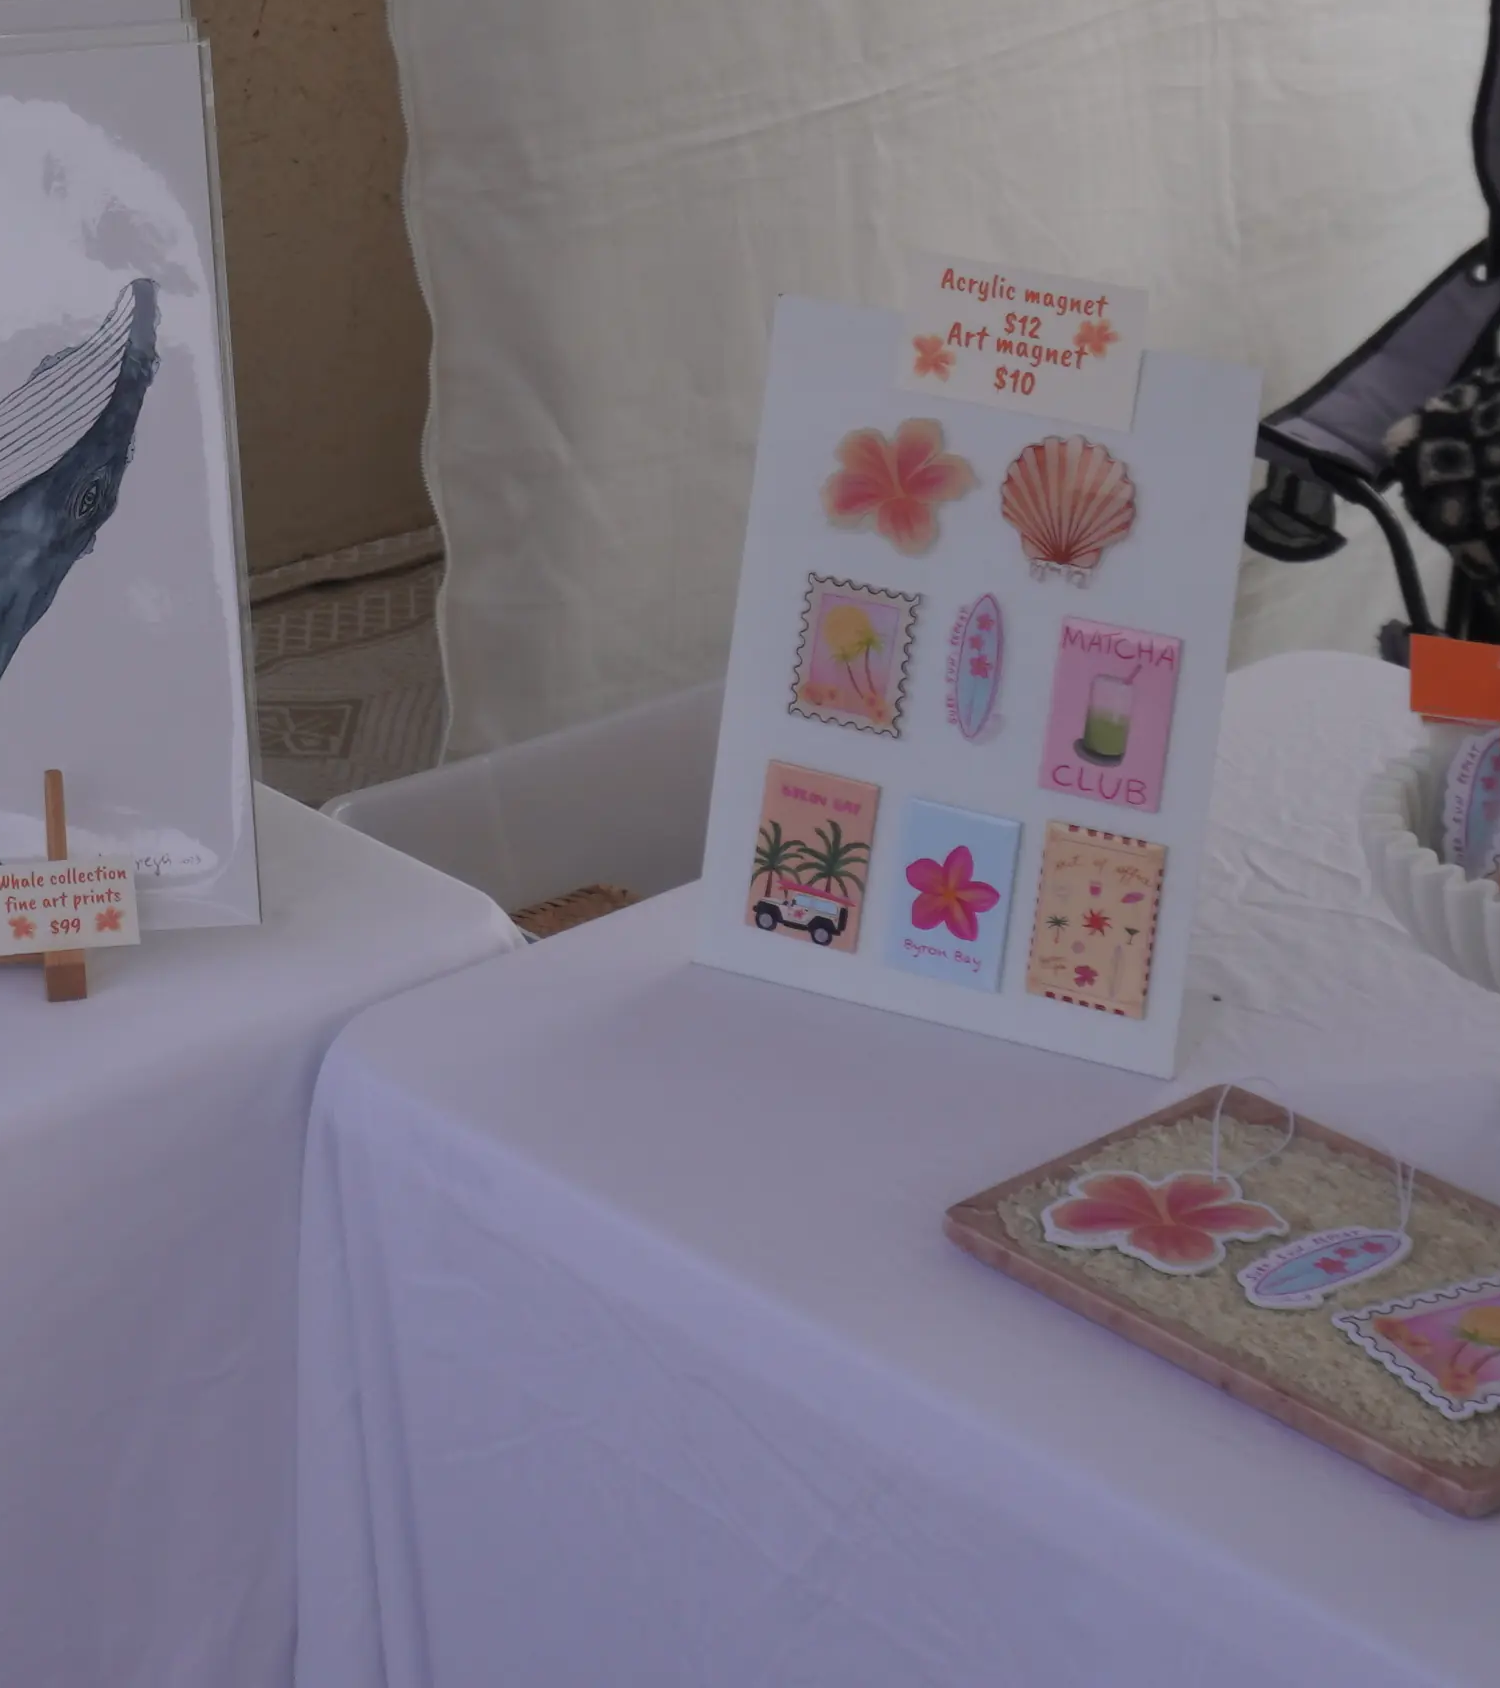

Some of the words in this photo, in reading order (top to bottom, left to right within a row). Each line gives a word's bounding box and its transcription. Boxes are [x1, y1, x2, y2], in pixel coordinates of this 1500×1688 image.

[940, 267, 1017, 303] Acrylic
[1023, 294, 1110, 318] magnet
[1003, 311, 1042, 340] $12
[947, 321, 991, 352] Art
[996, 336, 1089, 370] magnet
[993, 365, 1036, 396] $10
[1061, 625, 1176, 671] MATCHA
[1051, 765, 1148, 806] CLUB
[49, 865, 127, 886] collection
[4, 895, 37, 914] fine
[42, 891, 69, 910] art
[73, 887, 123, 911] prints
[49, 917, 82, 935] $99
